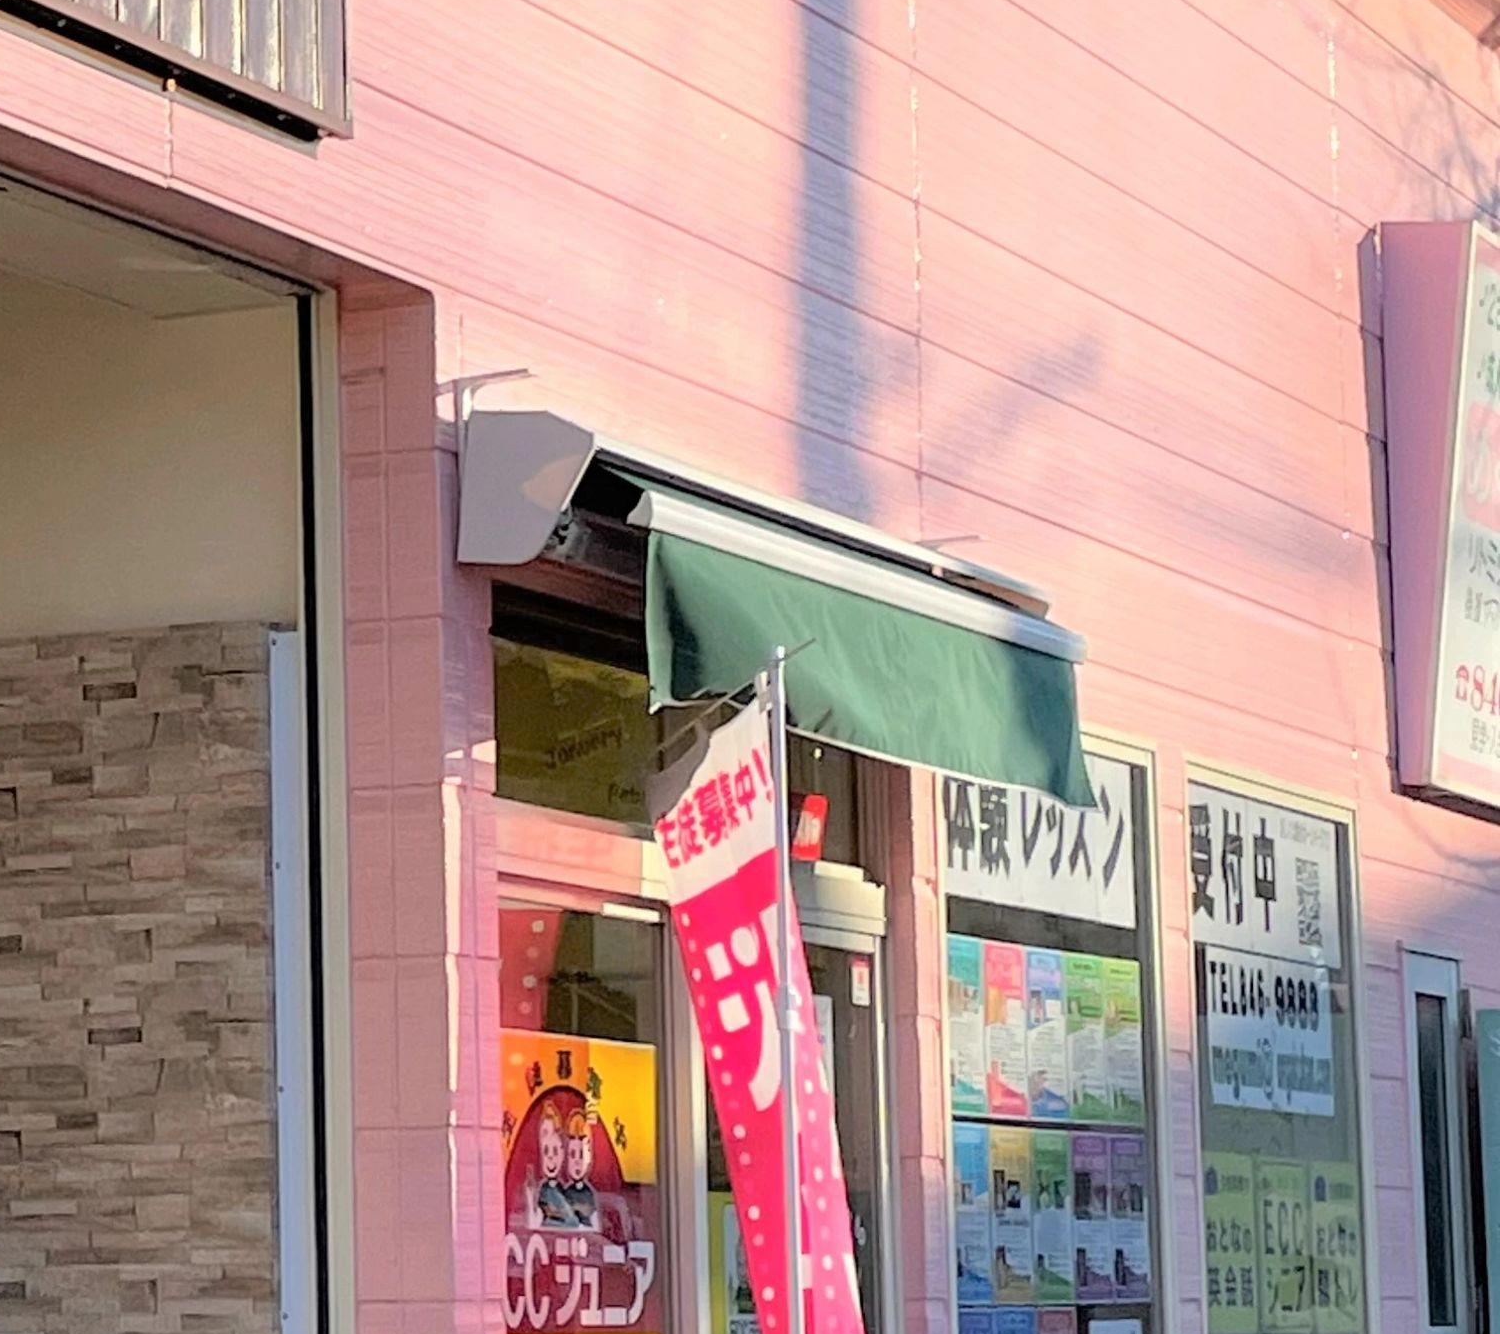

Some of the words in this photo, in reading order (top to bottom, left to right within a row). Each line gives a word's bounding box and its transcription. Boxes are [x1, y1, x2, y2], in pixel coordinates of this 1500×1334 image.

[1189, 803, 1276, 933] 受付中
[1263, 1200, 1304, 1256] ECC
